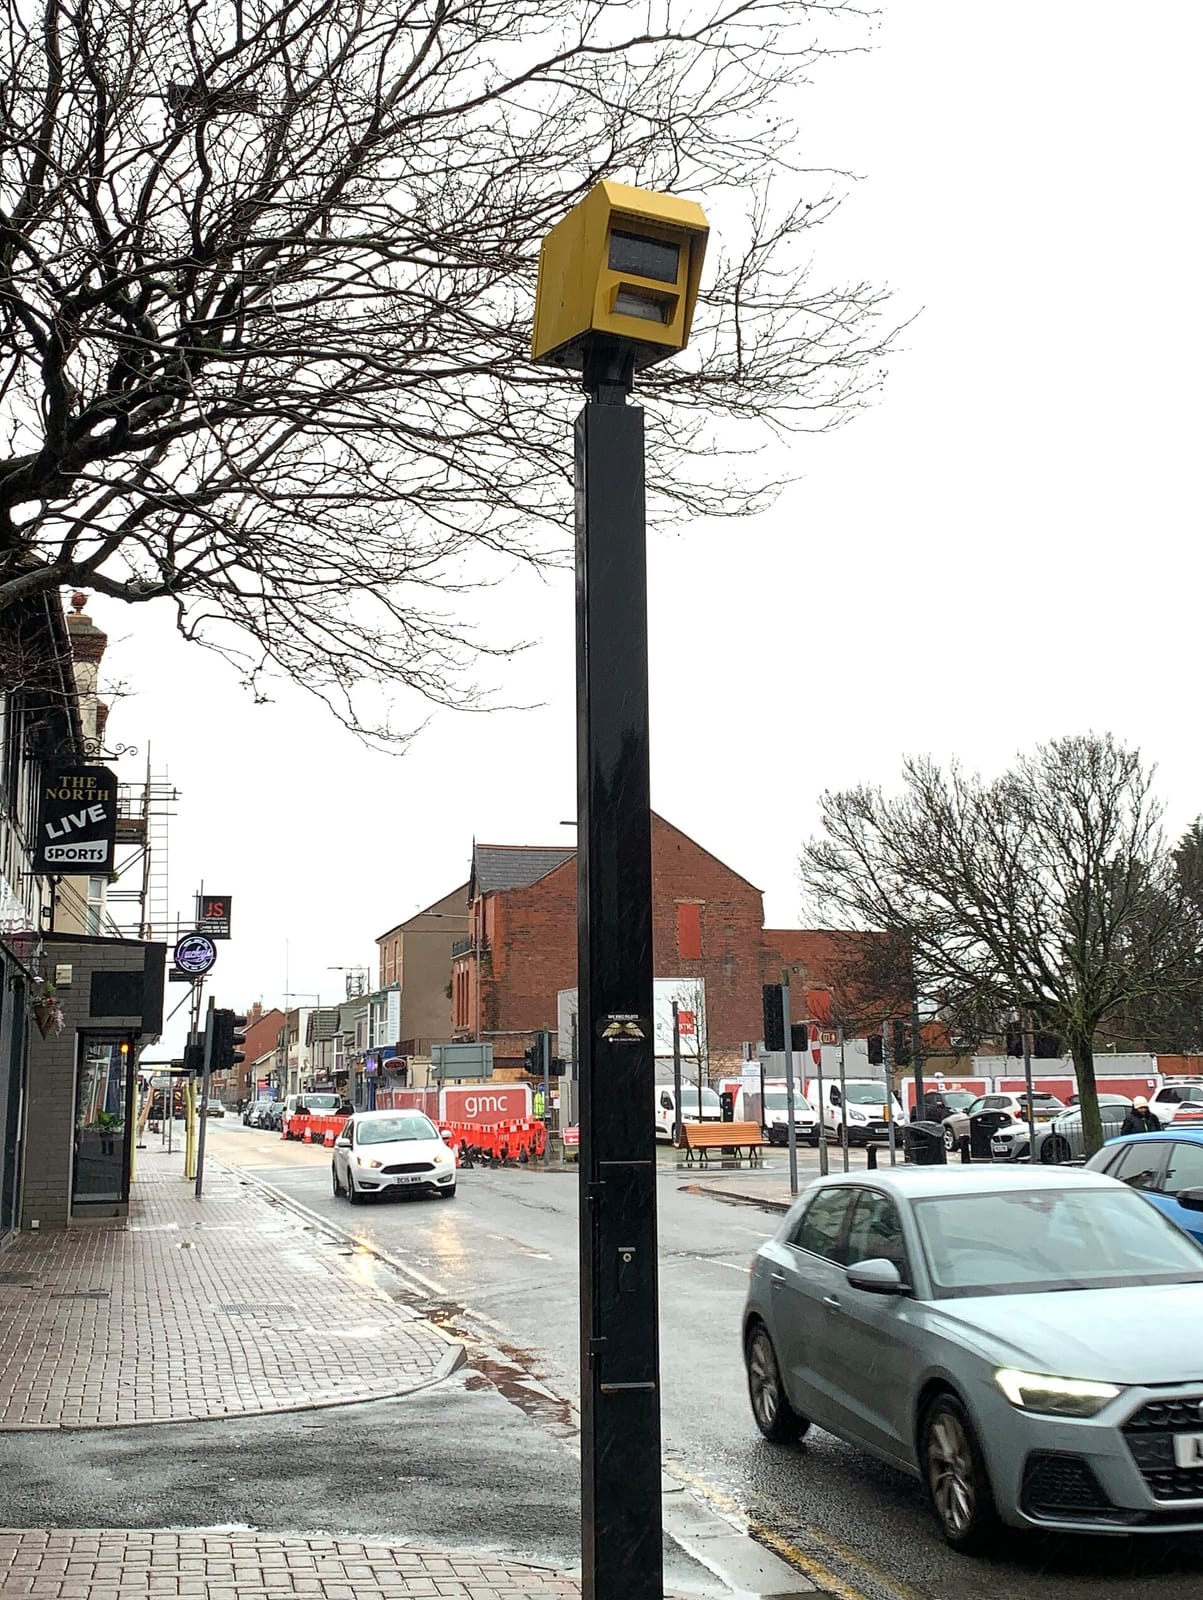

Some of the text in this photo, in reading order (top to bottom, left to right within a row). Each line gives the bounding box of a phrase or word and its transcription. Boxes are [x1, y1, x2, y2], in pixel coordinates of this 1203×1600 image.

[59, 776, 97, 788] THE
[45, 788, 110, 801] NORTH
[45, 803, 107, 839] LIVE
[47, 848, 104, 860] SPORTS
[465, 1095, 508, 1118] gmc
